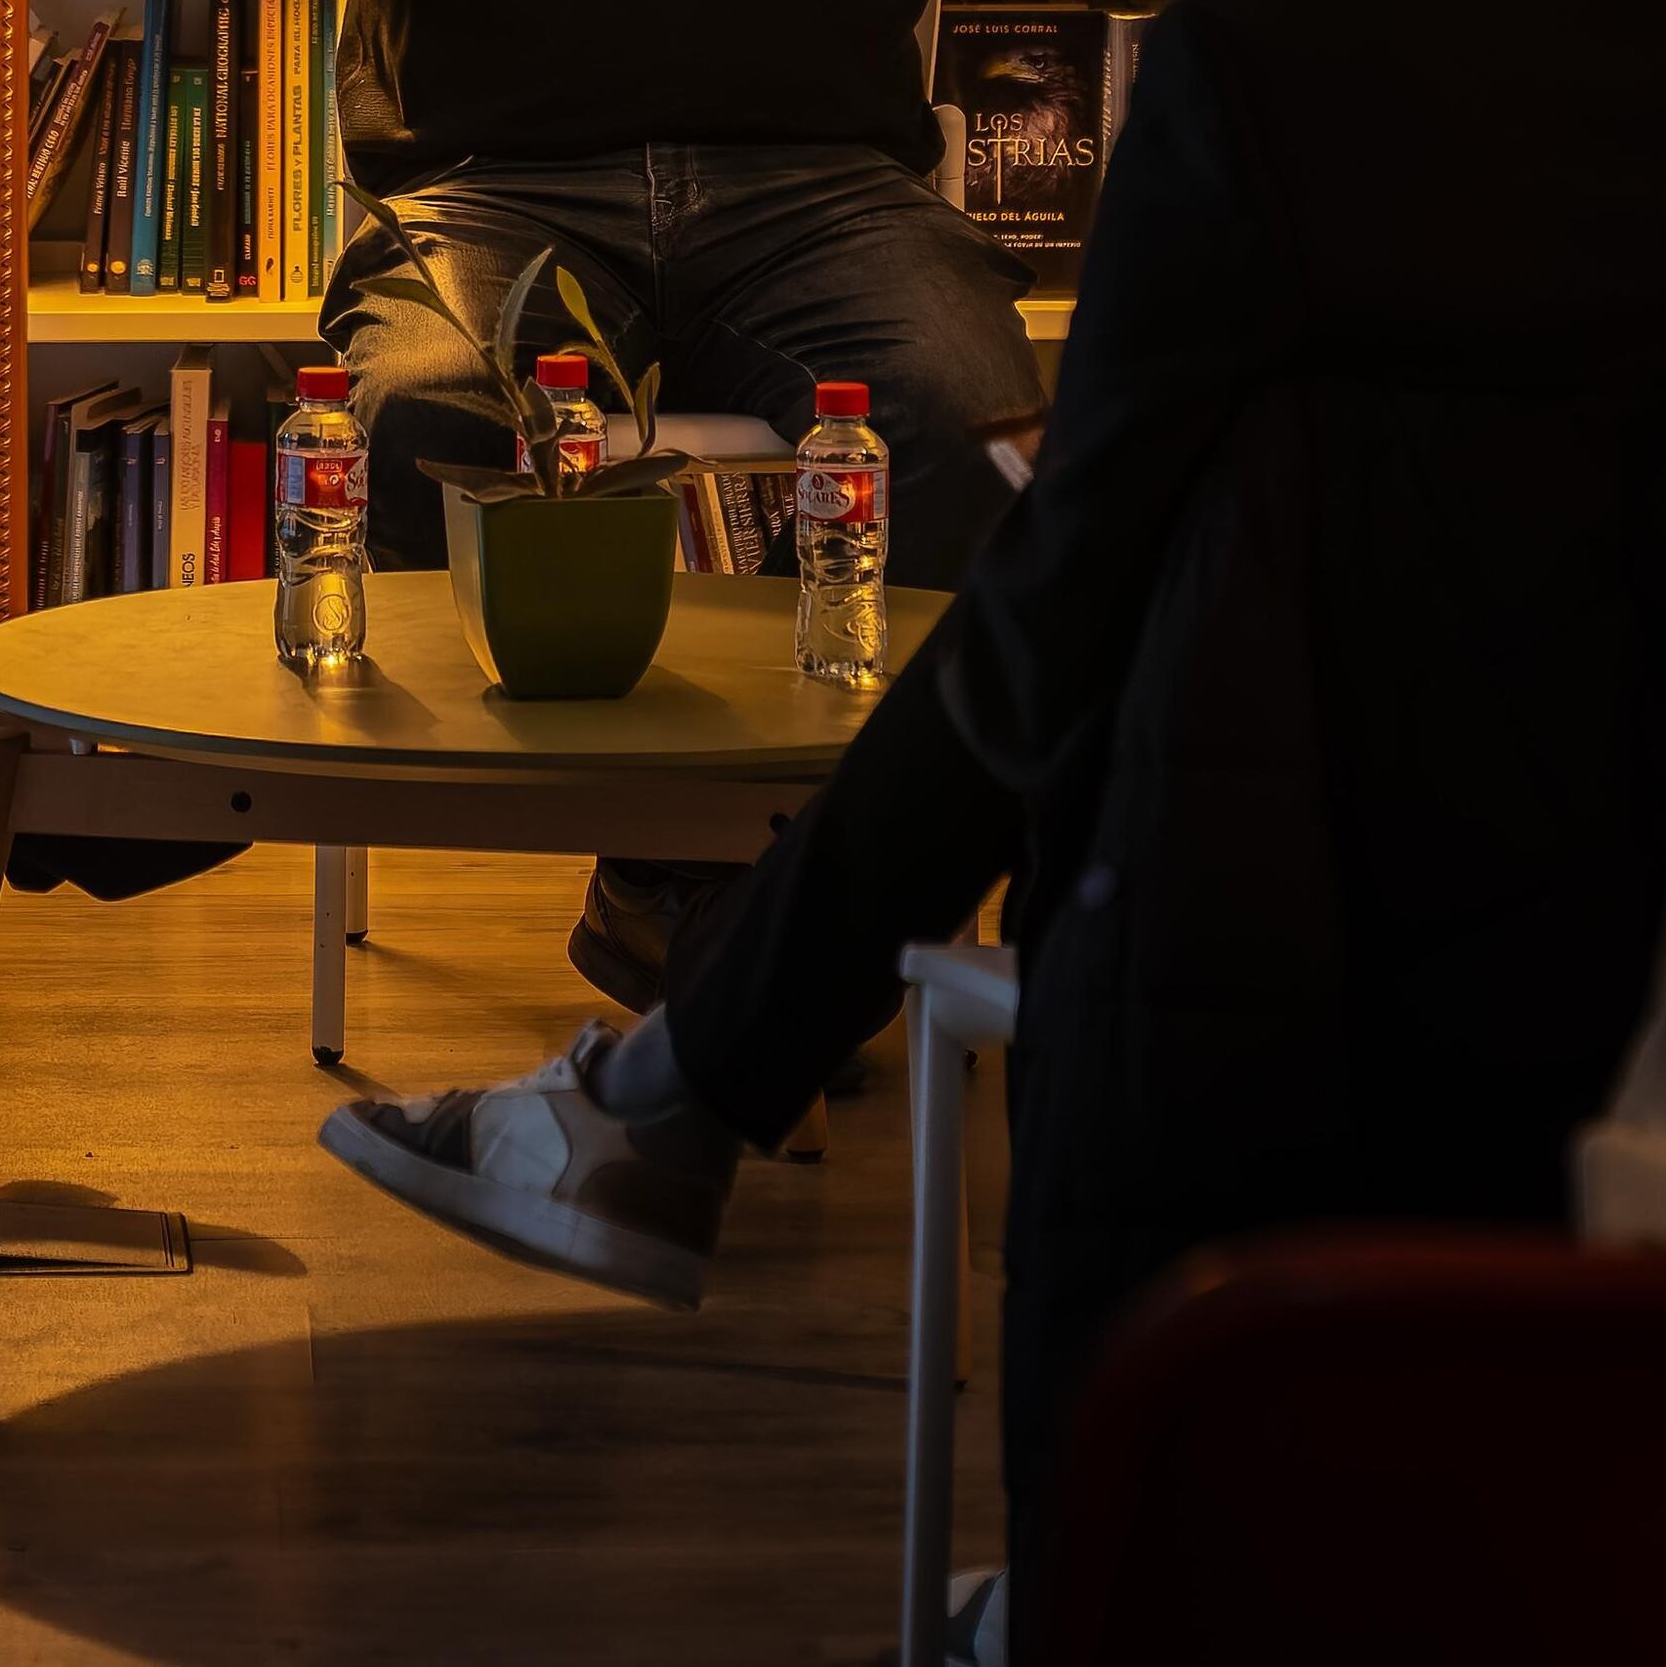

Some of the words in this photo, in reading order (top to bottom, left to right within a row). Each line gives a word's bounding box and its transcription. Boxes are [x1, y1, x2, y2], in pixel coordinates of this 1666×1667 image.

[953, 23, 980, 34] JOSÉ
[986, 24, 1009, 34] LUIS
[1014, 24, 1058, 34] CORRAL
[291, 85, 303, 156] PLANTAS
[975, 114, 1024, 132] LOS
[967, 135, 1094, 168] STRIAS
[291, 169, 303, 233] FLORES
[1001, 212, 1021, 221] DEL
[1024, 210, 1065, 222] ÁGUILA
